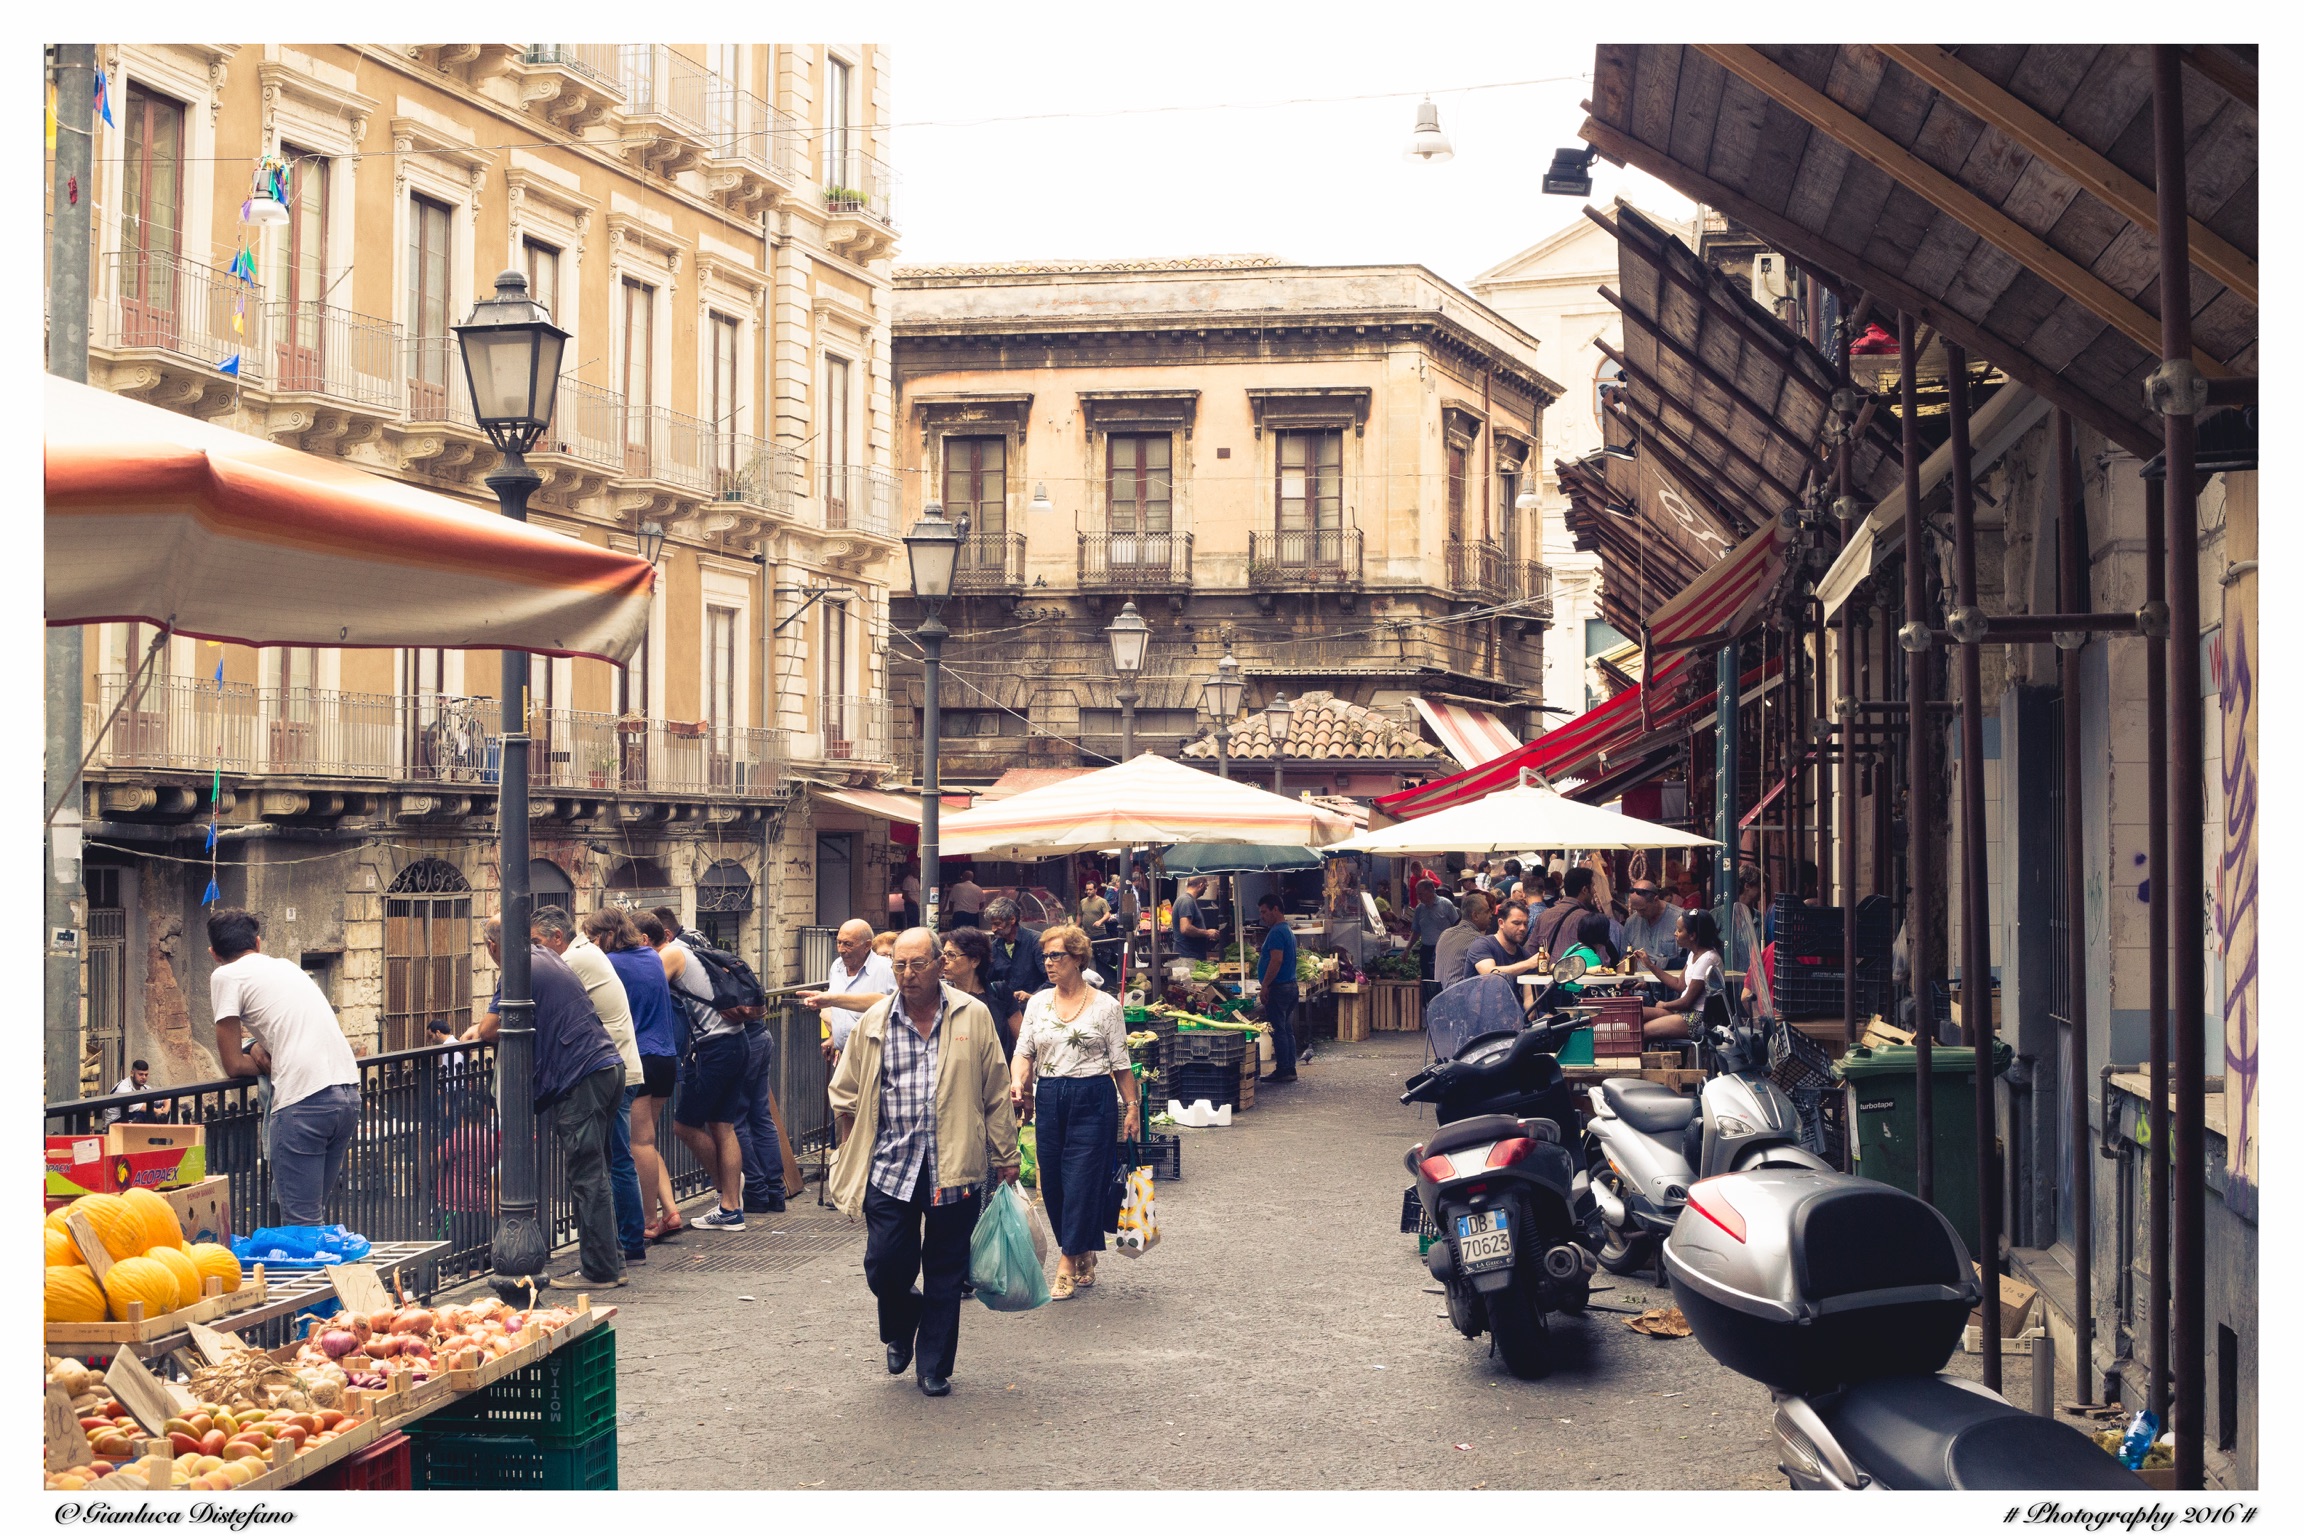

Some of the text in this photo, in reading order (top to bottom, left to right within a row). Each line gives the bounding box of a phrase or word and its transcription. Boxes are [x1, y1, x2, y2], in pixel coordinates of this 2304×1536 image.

[1860, 1101, 1894, 1110] turbotape
[133, 1167, 179, 1186] ACOPAEX
[1468, 1214, 1488, 1234] DB
[1462, 1233, 1510, 1260] 70623
[550, 1367, 561, 1422] MOTTA
